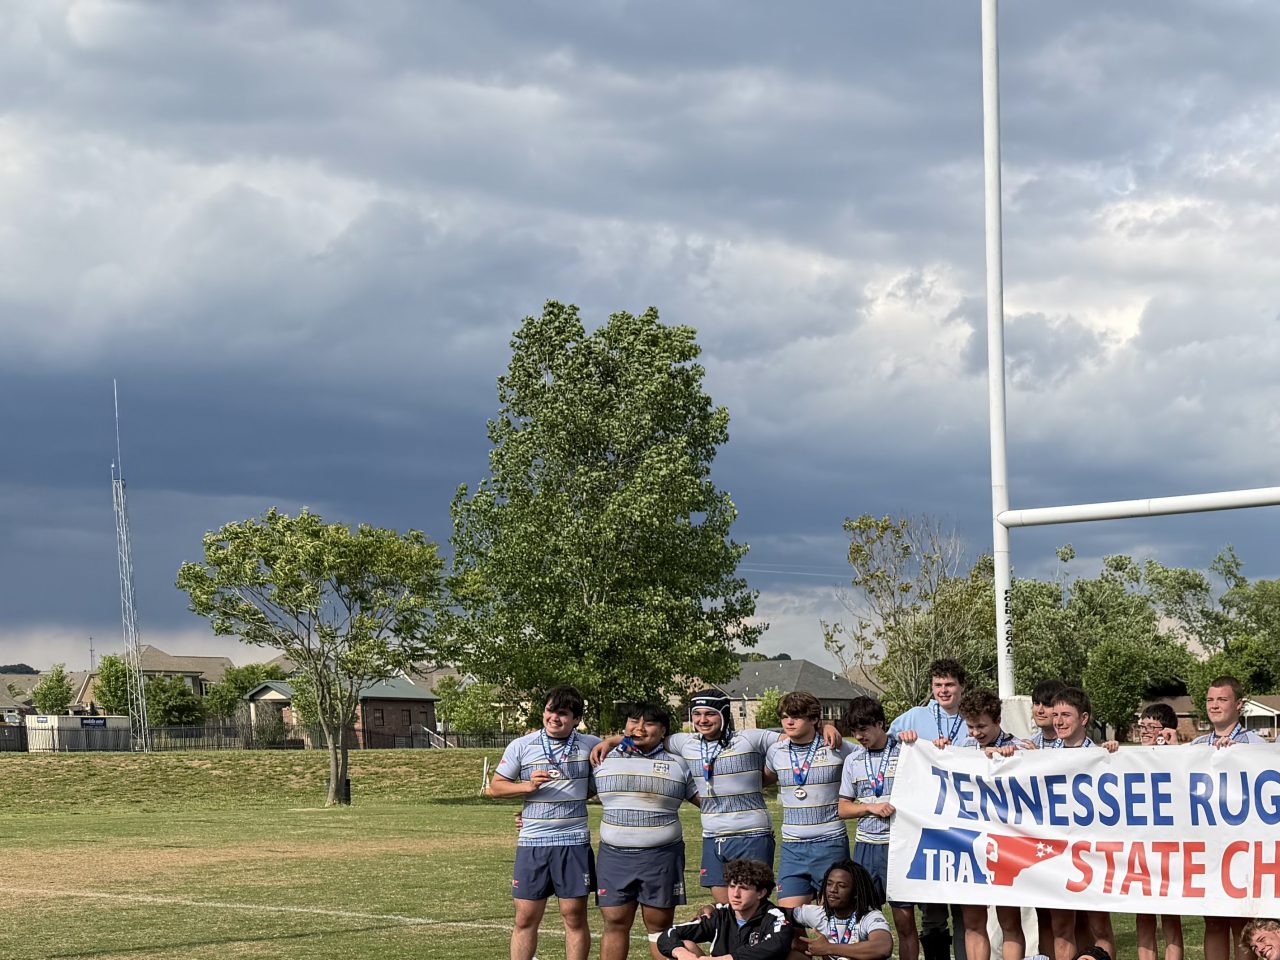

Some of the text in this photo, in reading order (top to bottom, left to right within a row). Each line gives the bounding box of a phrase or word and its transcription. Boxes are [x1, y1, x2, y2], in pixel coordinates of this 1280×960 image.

[931, 765, 1174, 827] TENNESSEE
[922, 848, 976, 885] TRA
[1065, 840, 1206, 898] STATE
